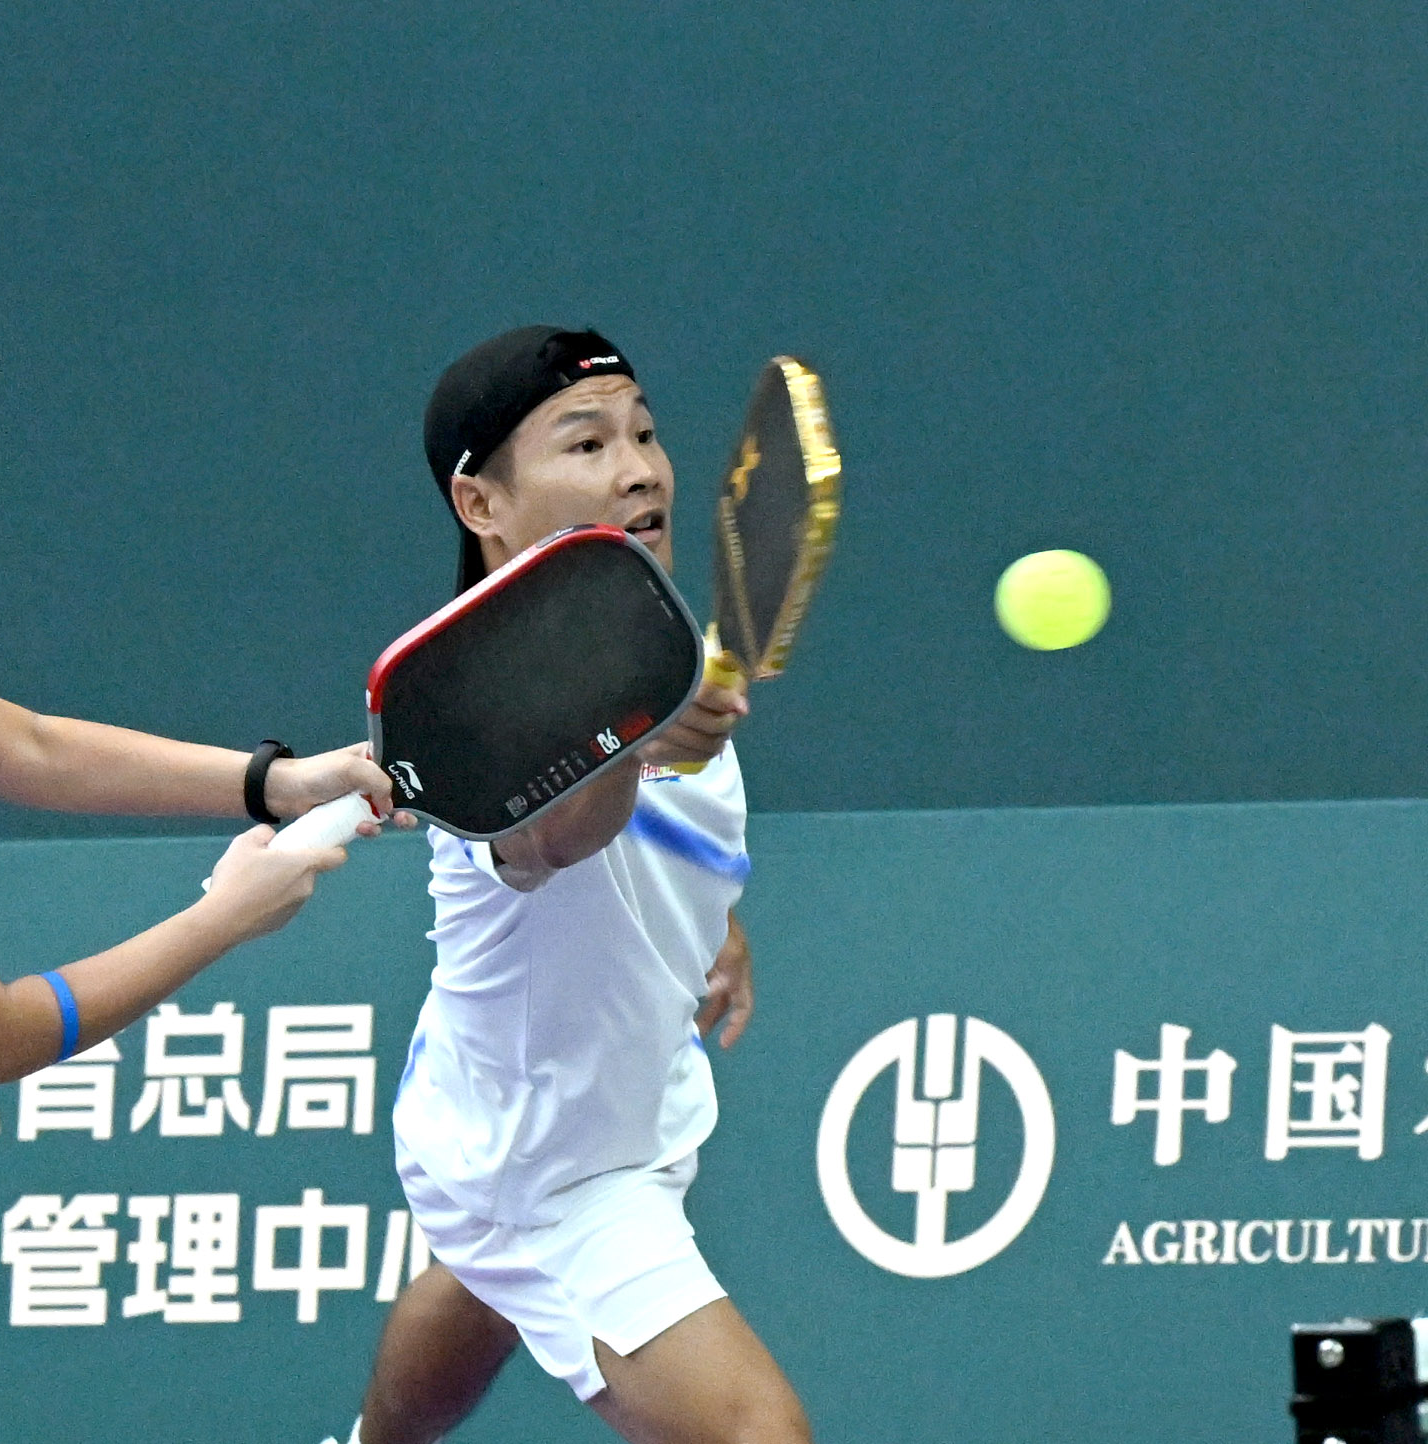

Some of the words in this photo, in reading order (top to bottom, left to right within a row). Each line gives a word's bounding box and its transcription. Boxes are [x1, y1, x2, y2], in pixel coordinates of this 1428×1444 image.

[388, 764, 416, 800] LI-NING
[1111, 1022, 1428, 1166] 中国
[1103, 1218, 1428, 1265] AGRICULTU
